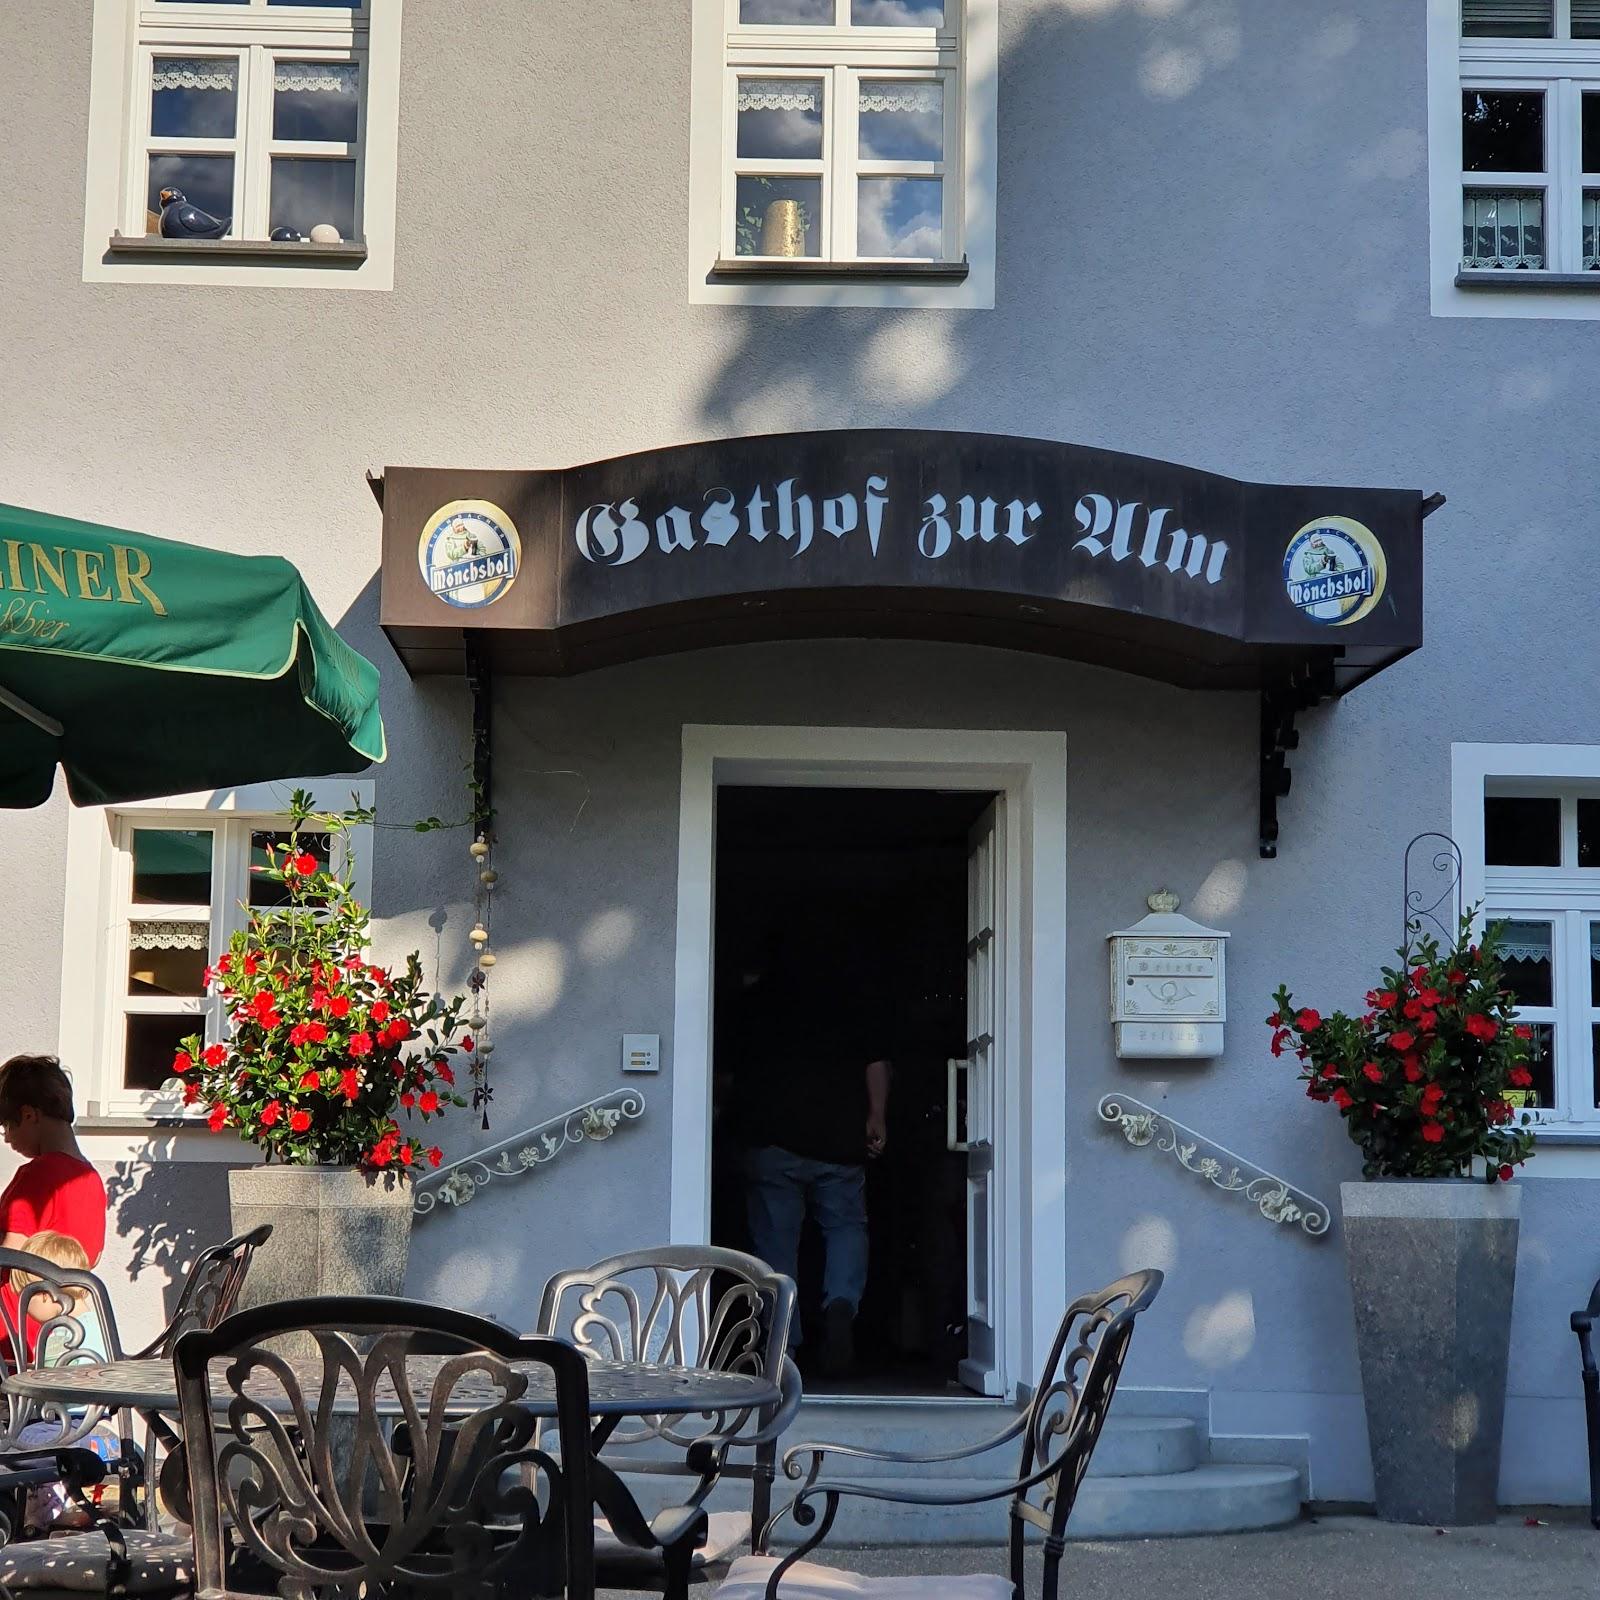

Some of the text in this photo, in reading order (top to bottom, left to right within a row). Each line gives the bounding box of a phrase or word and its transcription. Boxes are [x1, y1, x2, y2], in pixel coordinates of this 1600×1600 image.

[575, 475, 1231, 585] Gasthof zur Alm
[0, 538, 168, 617] INER
[433, 552, 509, 591] Mönchshof
[1290, 569, 1367, 604] Mönchshof
[0, 597, 70, 640] ßbier
